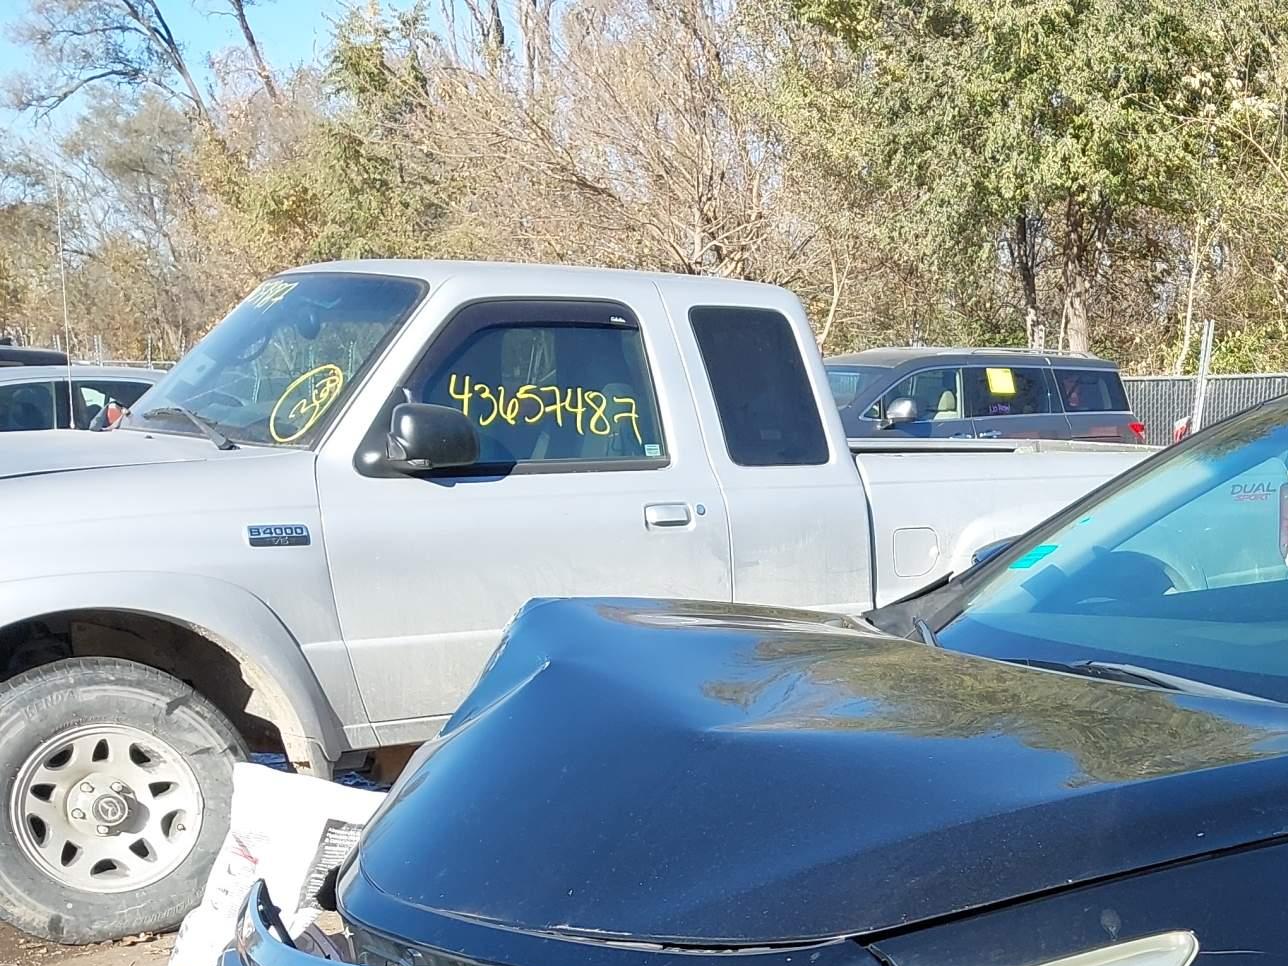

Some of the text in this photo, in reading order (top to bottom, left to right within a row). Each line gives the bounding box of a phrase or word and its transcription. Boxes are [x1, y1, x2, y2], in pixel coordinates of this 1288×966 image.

[449, 374, 643, 445] 43657487
[1231, 481, 1276, 495] DUAL
[249, 526, 305, 537] B4000
